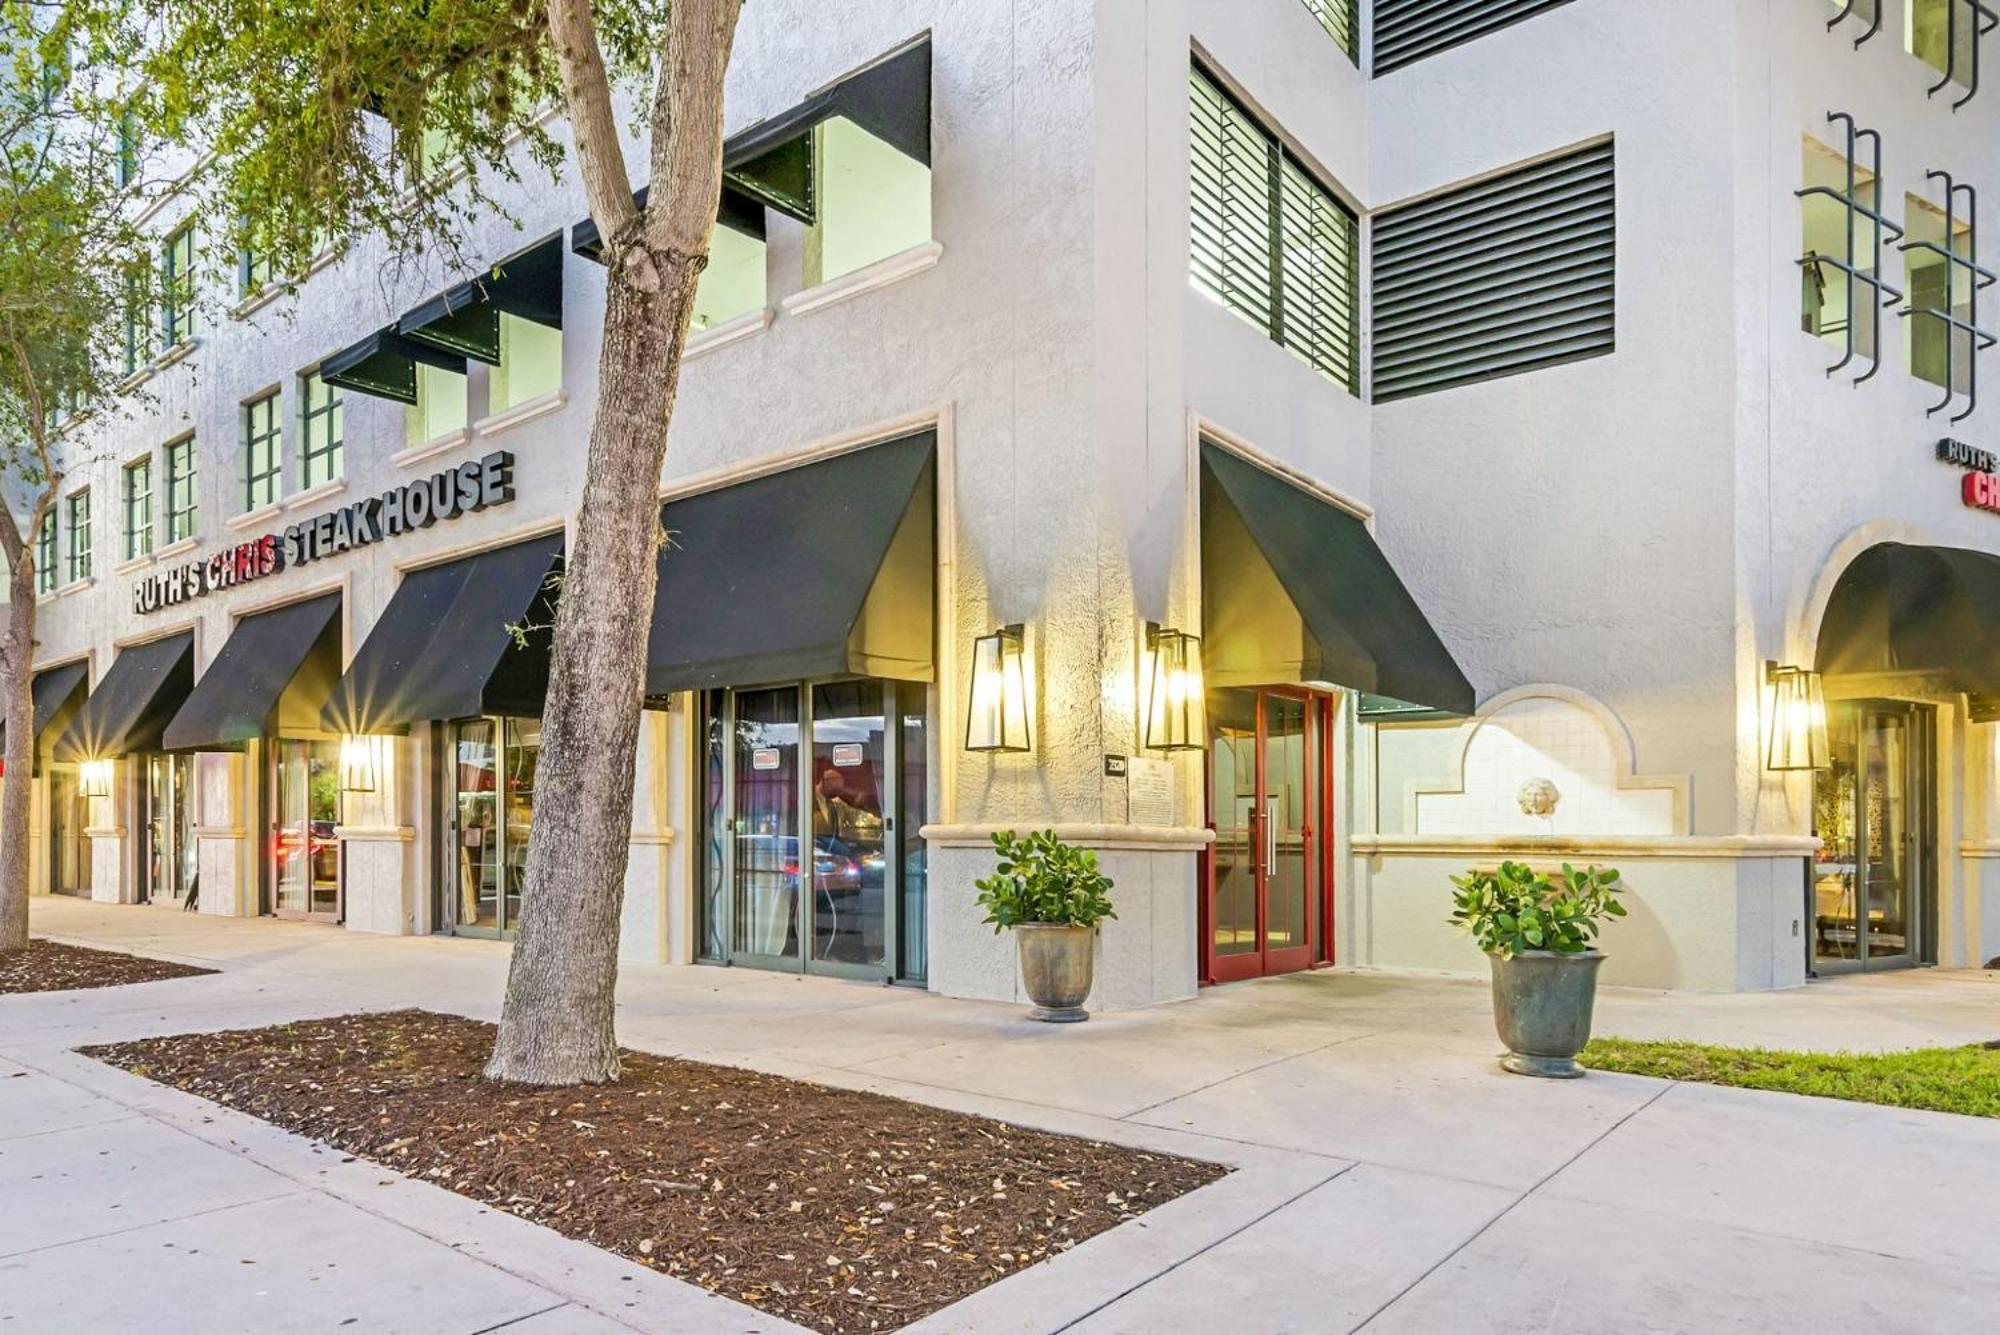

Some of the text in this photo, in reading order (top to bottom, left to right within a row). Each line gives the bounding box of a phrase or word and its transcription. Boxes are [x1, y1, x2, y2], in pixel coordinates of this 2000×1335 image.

[132, 451, 514, 614] RUTH'S CHRIS STEAK HOUSE
